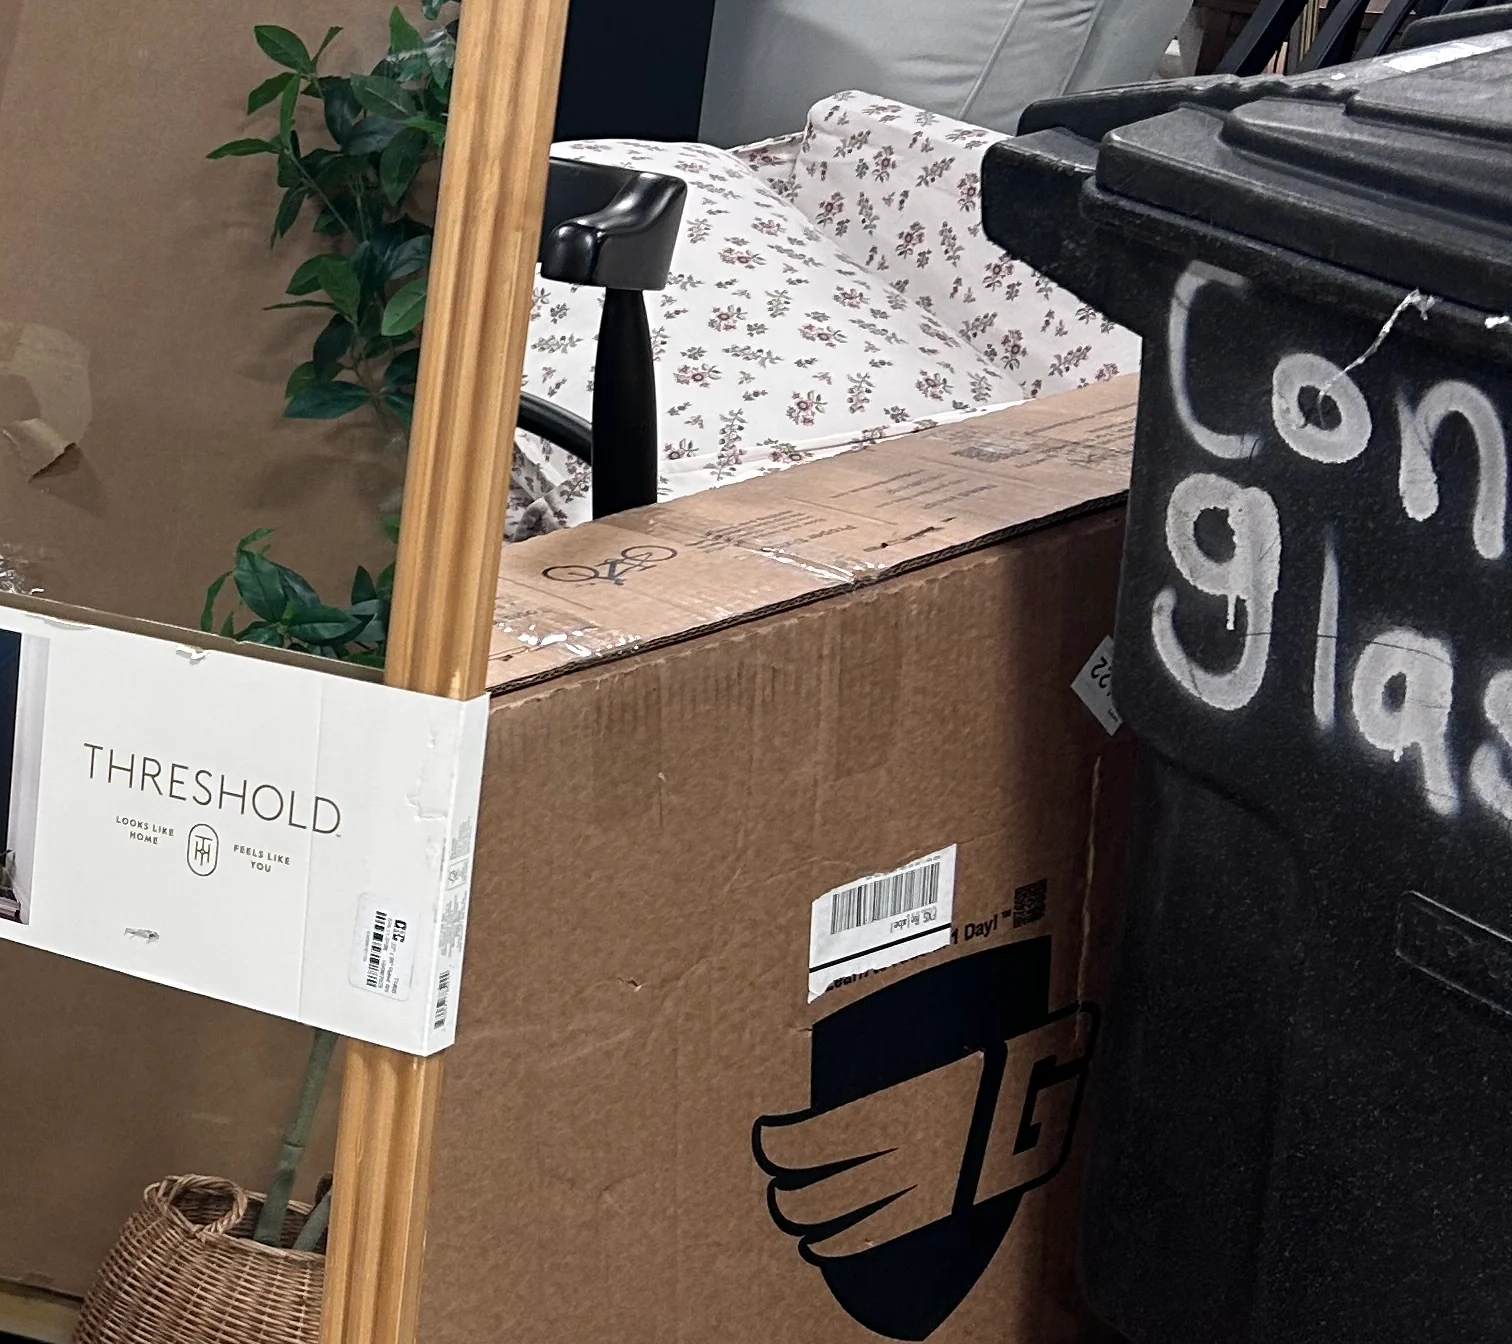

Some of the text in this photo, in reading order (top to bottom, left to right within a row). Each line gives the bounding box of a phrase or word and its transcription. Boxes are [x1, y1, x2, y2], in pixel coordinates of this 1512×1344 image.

[84, 742, 342, 835] THRESHOLD
[116, 815, 175, 837] LOOKS LIKE
[129, 830, 159, 845] HOME
[233, 844, 291, 866] FEELS LIKE
[250, 860, 272, 873] YOU
